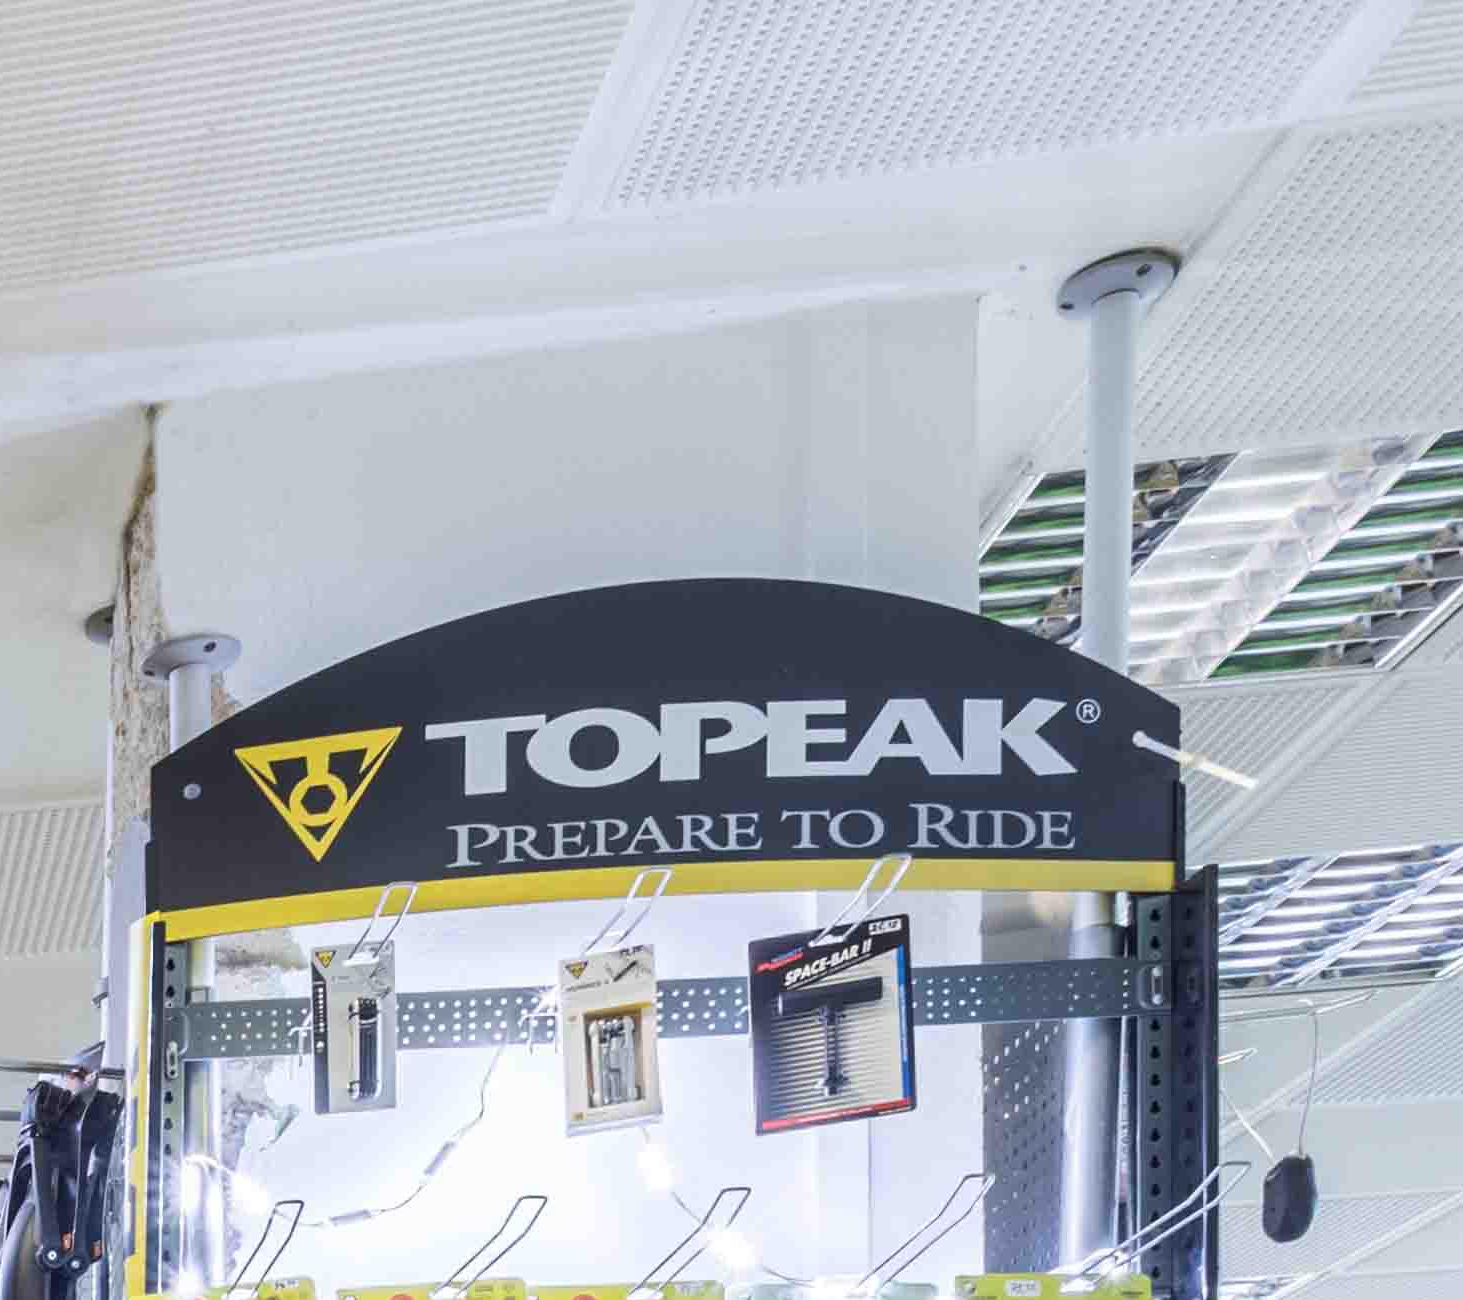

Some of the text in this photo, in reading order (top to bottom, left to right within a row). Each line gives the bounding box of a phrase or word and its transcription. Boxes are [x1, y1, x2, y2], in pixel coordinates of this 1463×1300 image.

[424, 697, 1078, 797] TOPEAK
[446, 802, 1076, 869] PREPARE TO RIDE
[783, 943, 860, 987] SPACE-BAR
